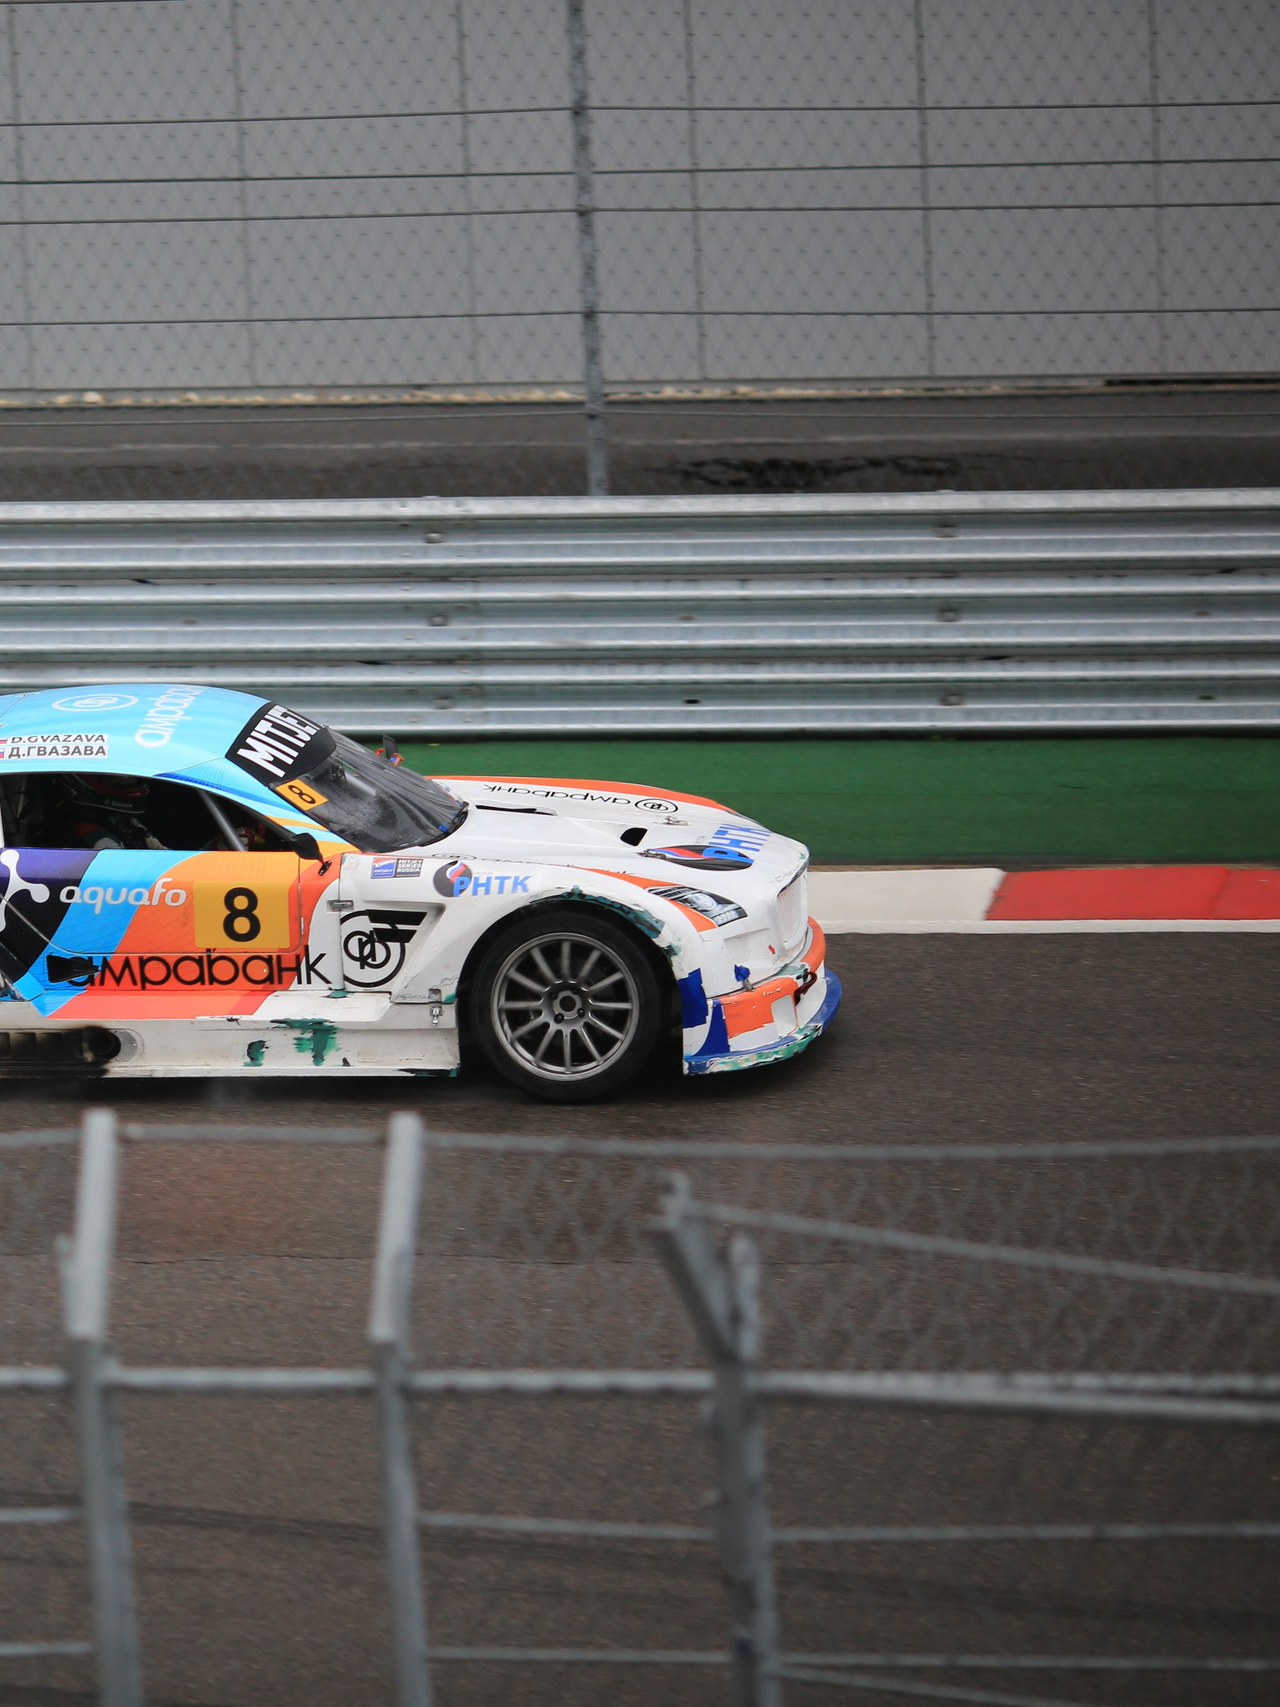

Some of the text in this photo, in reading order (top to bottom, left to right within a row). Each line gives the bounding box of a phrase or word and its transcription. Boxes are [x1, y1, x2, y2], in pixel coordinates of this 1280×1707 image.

[11, 734, 105, 743] D.GVAZAVA
[8, 745, 106, 758] Д.ГВАЗАВА
[288, 785, 316, 804] 8
[223, 887, 261, 942] 8
